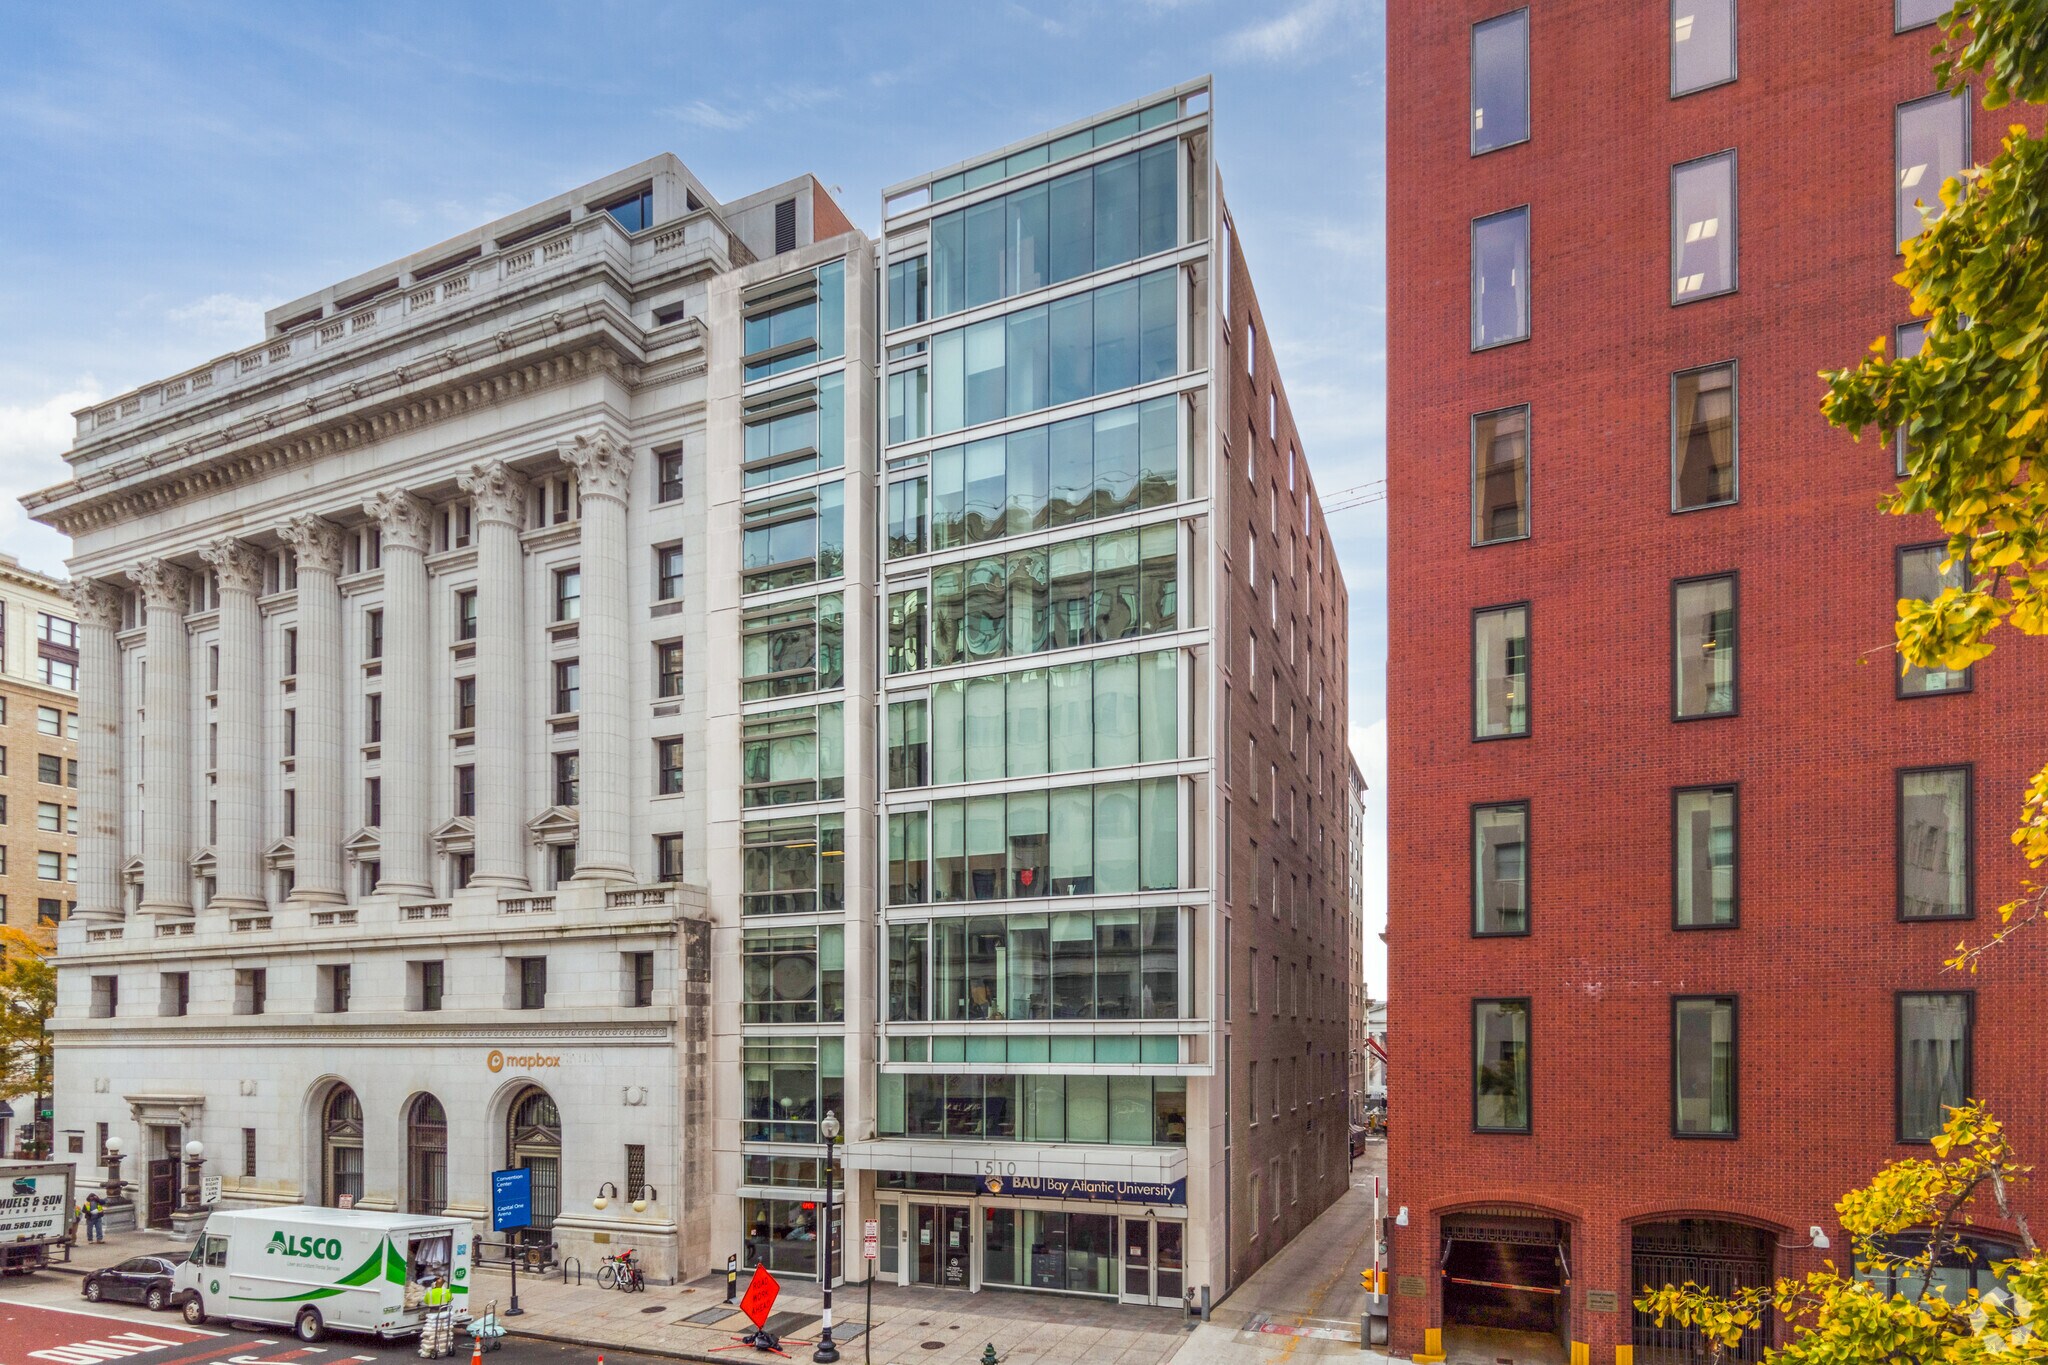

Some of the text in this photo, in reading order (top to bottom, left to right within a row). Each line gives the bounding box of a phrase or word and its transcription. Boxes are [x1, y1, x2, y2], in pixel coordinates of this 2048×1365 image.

[506, 1053, 560, 1070] mapbox
[975, 1161, 1017, 1175] 1510
[496, 1174, 523, 1182] Convention
[1012, 1177, 1176, 1200] BAU Bay Atlantic University
[32, 1196, 40, 1206] &
[42, 1195, 63, 1205] SON
[497, 1204, 514, 1212] Capital
[264, 1231, 342, 1260] ALSCO
[753, 1276, 768, 1288] ROAD
[753, 1290, 769, 1301] WORK
[751, 1300, 771, 1314] AHEAD
[27, 1332, 184, 1365] ONLY
